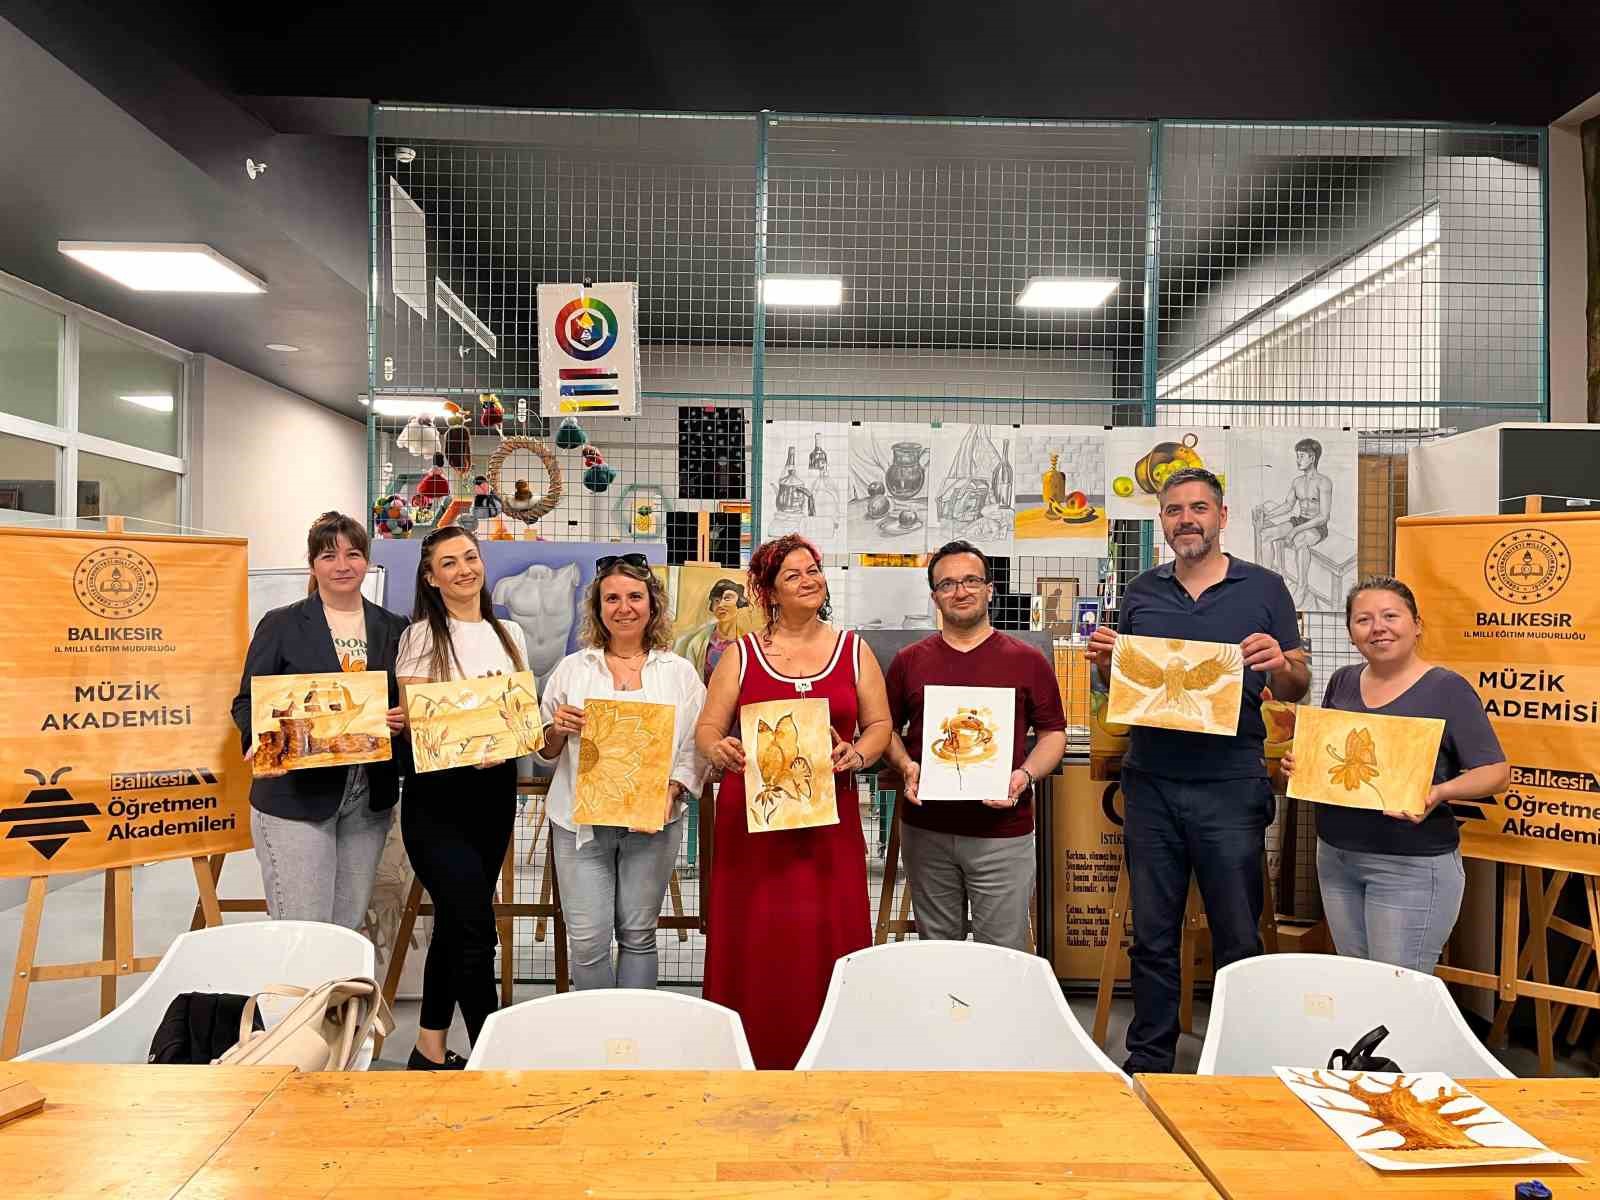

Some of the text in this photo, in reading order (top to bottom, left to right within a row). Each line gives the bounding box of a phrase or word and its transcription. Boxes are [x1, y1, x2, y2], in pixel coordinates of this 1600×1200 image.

[75, 680, 160, 703] MÜZİK
[1479, 668, 1565, 692] MÜZİK
[41, 705, 191, 731] AKADEMİSİ
[111, 769, 192, 790] Balıkesir
[1511, 768, 1595, 790] Balıkesir
[108, 796, 217, 820] Öğretmen
[107, 813, 236, 840] Akademileri
